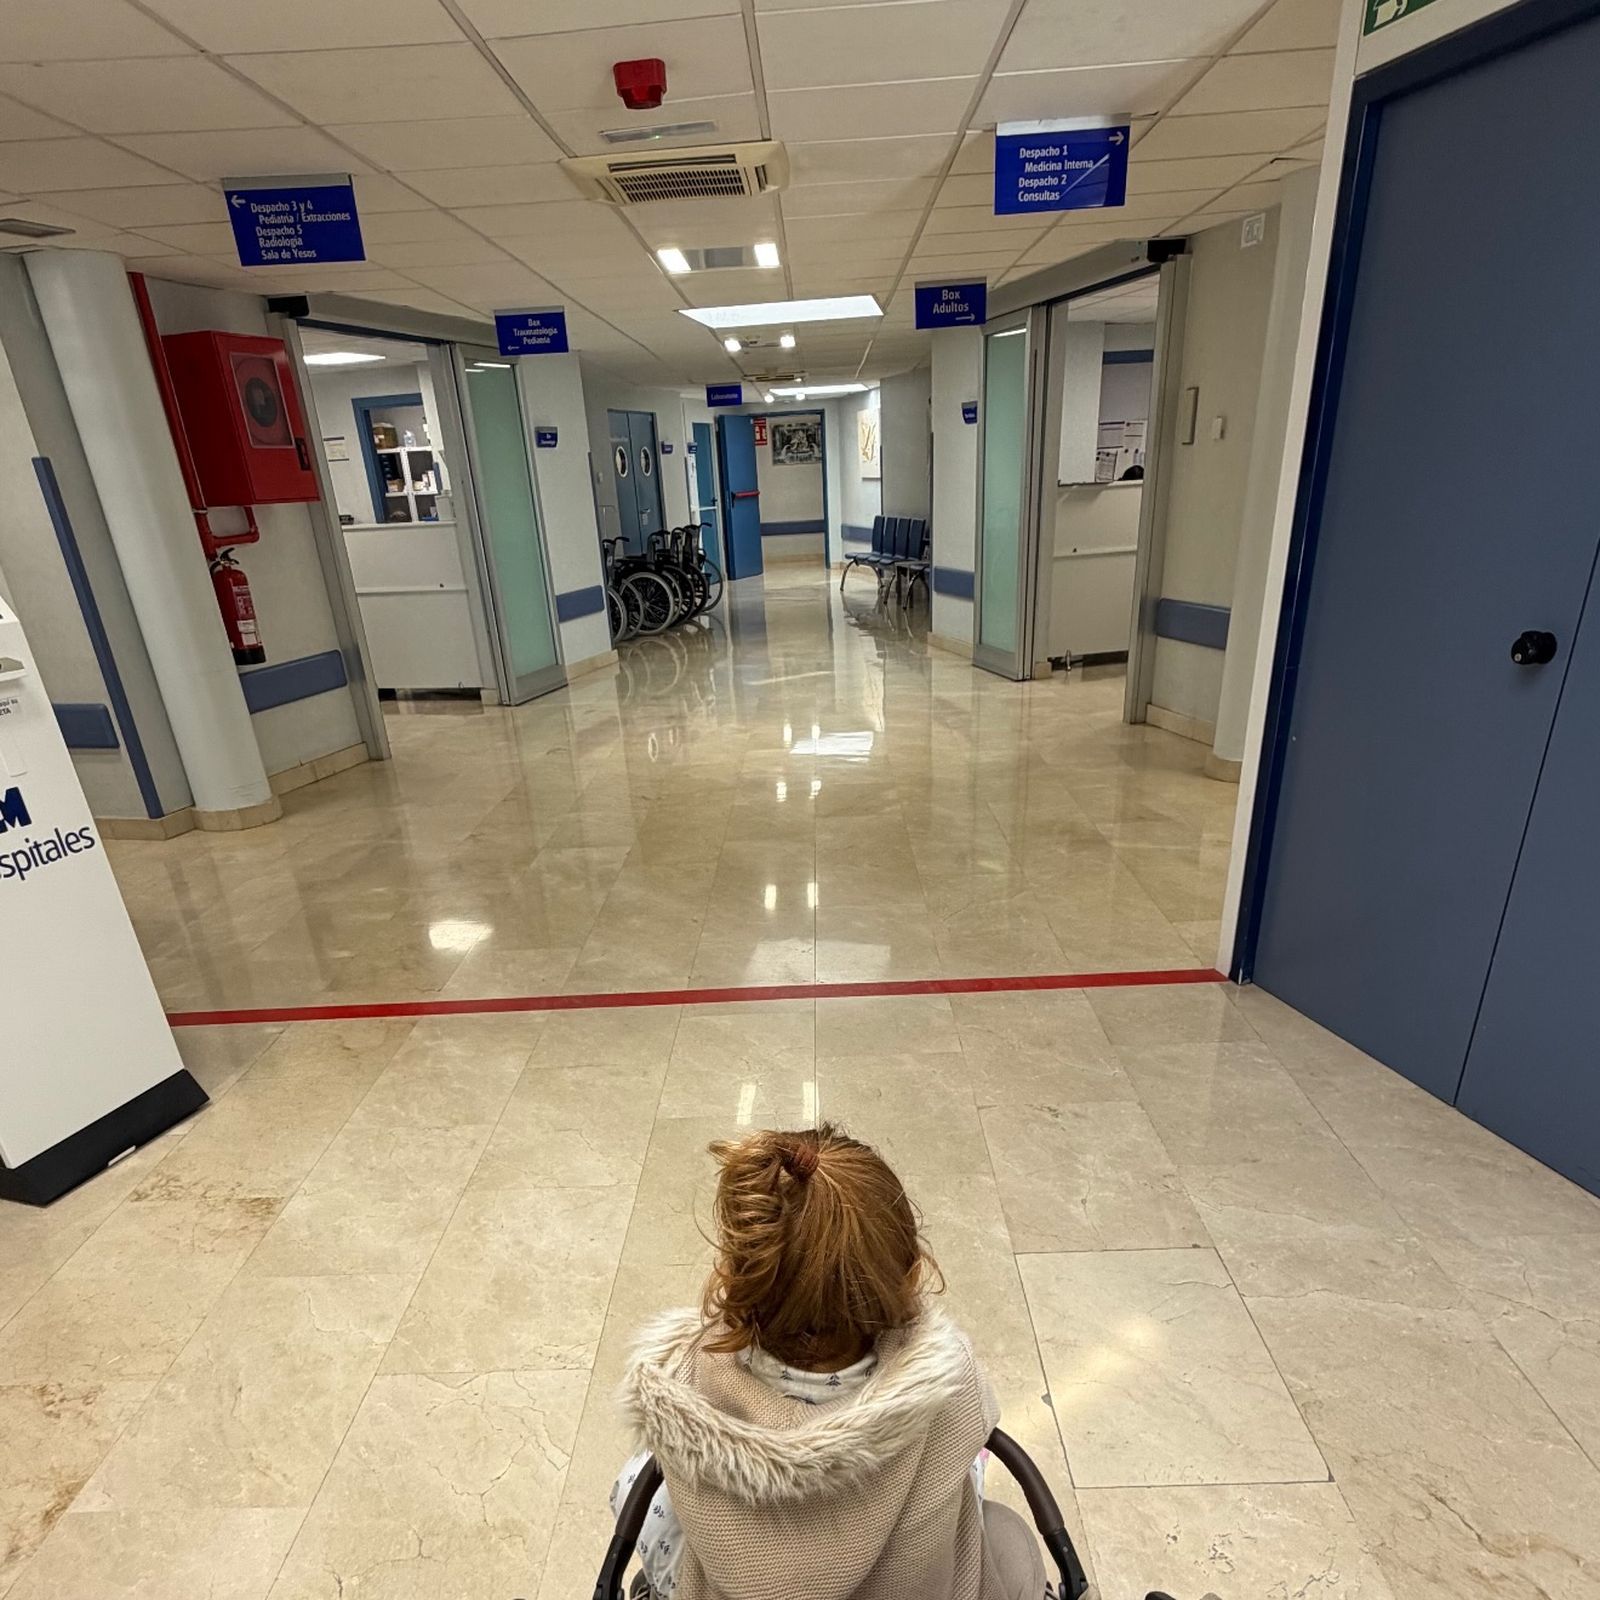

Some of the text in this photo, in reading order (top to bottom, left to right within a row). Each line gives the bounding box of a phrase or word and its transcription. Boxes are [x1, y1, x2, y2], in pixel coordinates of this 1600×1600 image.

[1019, 145, 1068, 159] Despacho 1
[1024, 159, 1094, 173] Medicina Interna
[1018, 174, 1067, 189] Despacho 2
[1018, 190, 1060, 202] Consultas
[250, 200, 313, 213] Despacho 3 y 4
[301, 211, 351, 223] Extracciones
[256, 224, 303, 237] Despacho 5
[261, 248, 317, 260] Sala de Yesos
[942, 289, 961, 300] Box
[932, 302, 969, 314] Adultos
[0, 826, 95, 881] spitales
